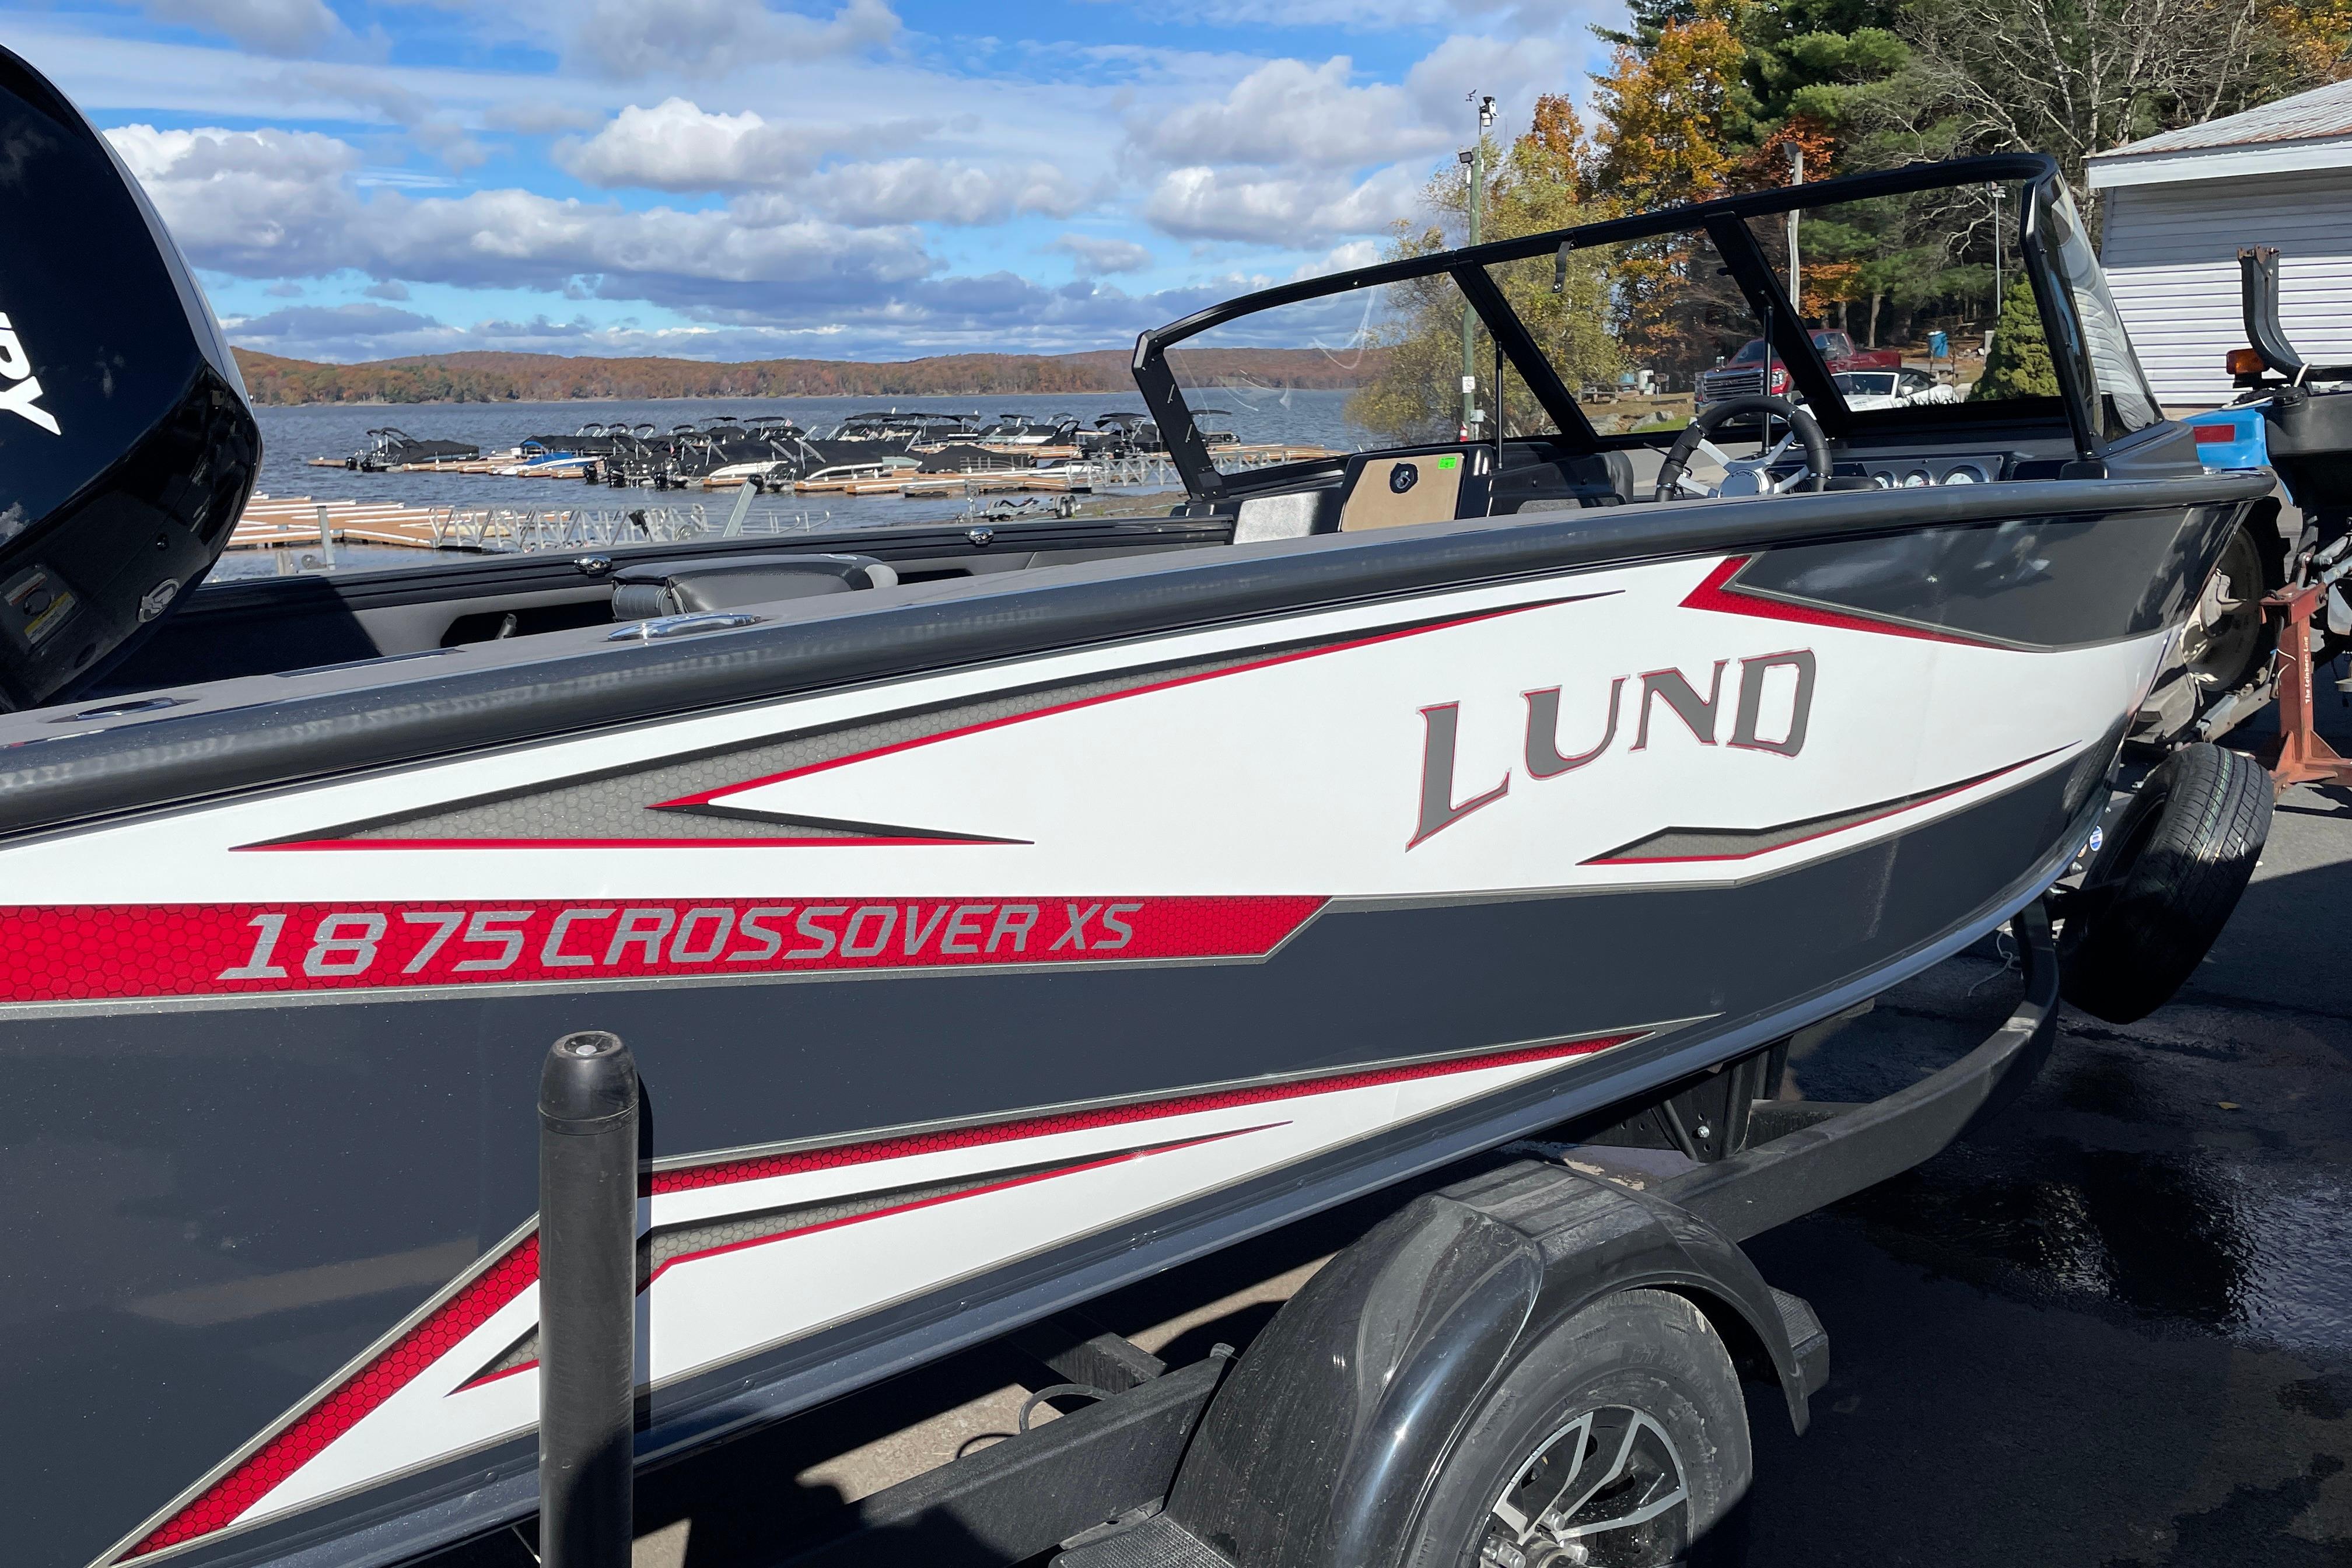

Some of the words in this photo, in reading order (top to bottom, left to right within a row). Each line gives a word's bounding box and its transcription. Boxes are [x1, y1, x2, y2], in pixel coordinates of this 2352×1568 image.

[1405, 646, 1817, 853] LUND
[216, 911, 536, 980] 1875
[540, 904, 1041, 968] CROSSOVER
[1048, 902, 1144, 951] XS
